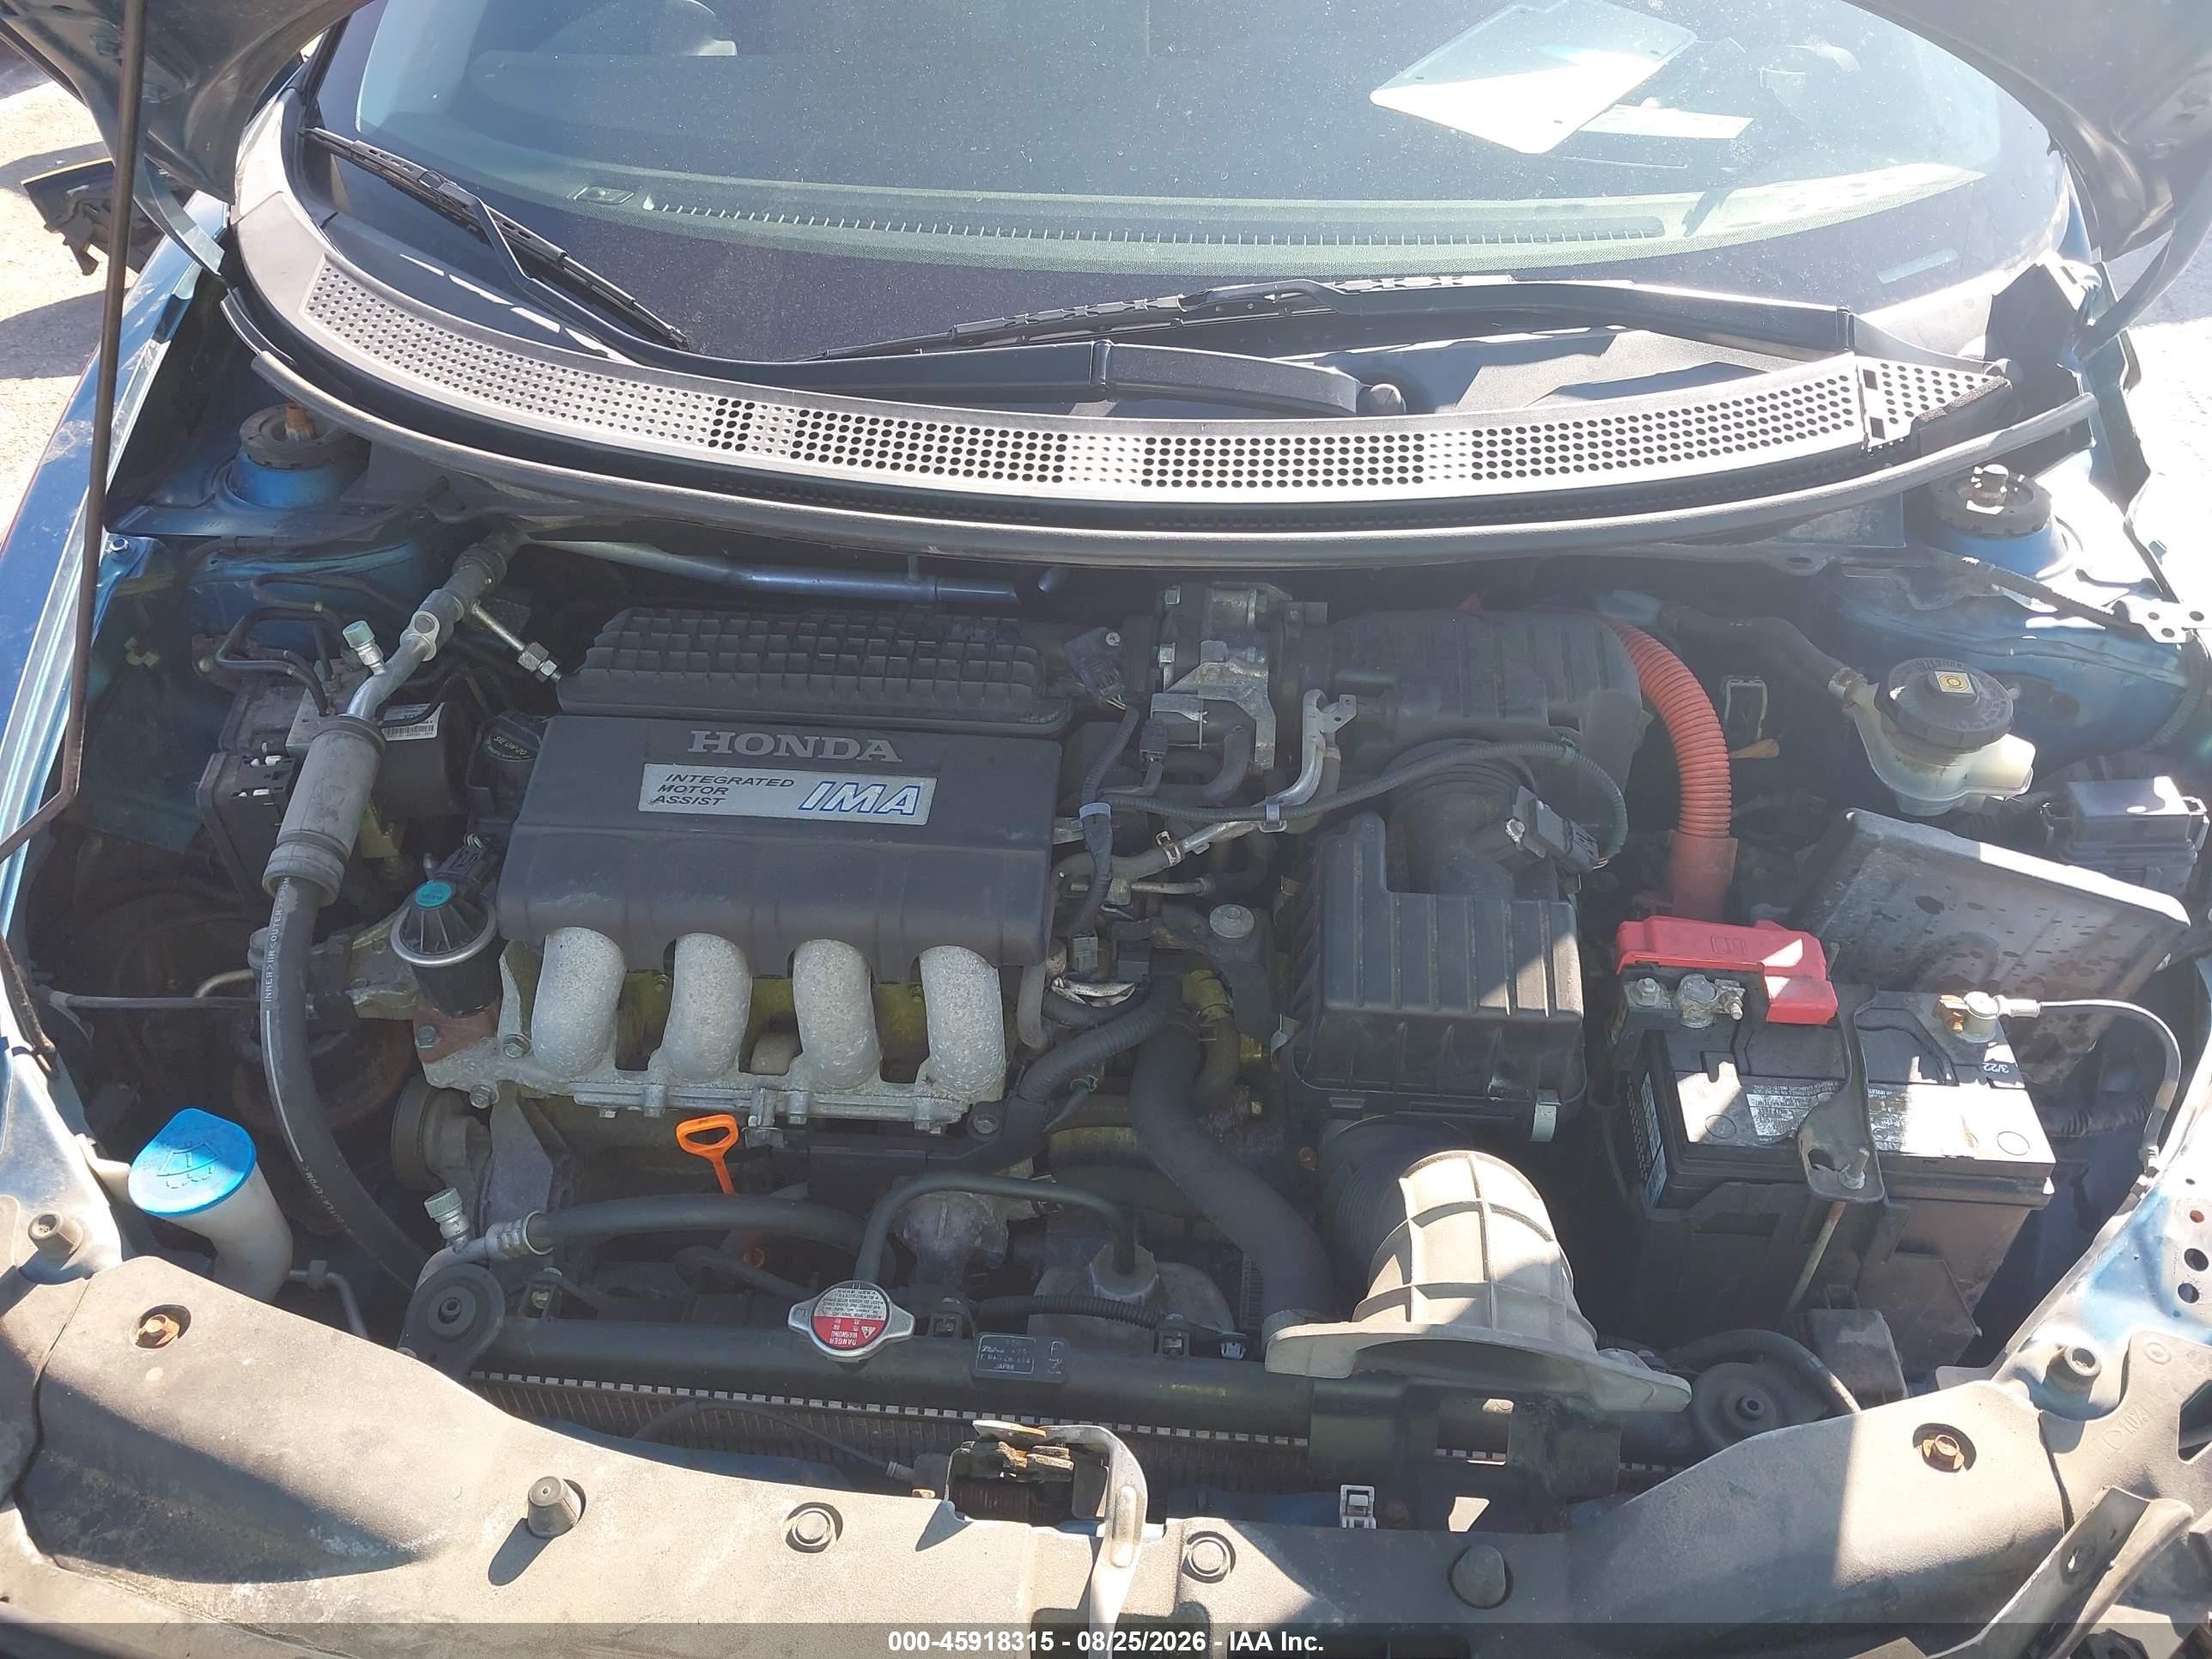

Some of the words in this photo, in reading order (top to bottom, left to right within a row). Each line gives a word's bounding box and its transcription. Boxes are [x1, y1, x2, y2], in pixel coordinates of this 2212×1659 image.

[687, 730, 902, 763] HONDA
[665, 774, 795, 787] INTEGRATED
[657, 784, 729, 796] MOTOR
[652, 795, 726, 807] ASSIST
[797, 780, 921, 816] IMA
[1982, 1062, 2009, 1073] 3/22
[829, 1337, 857, 1346] DANGER
